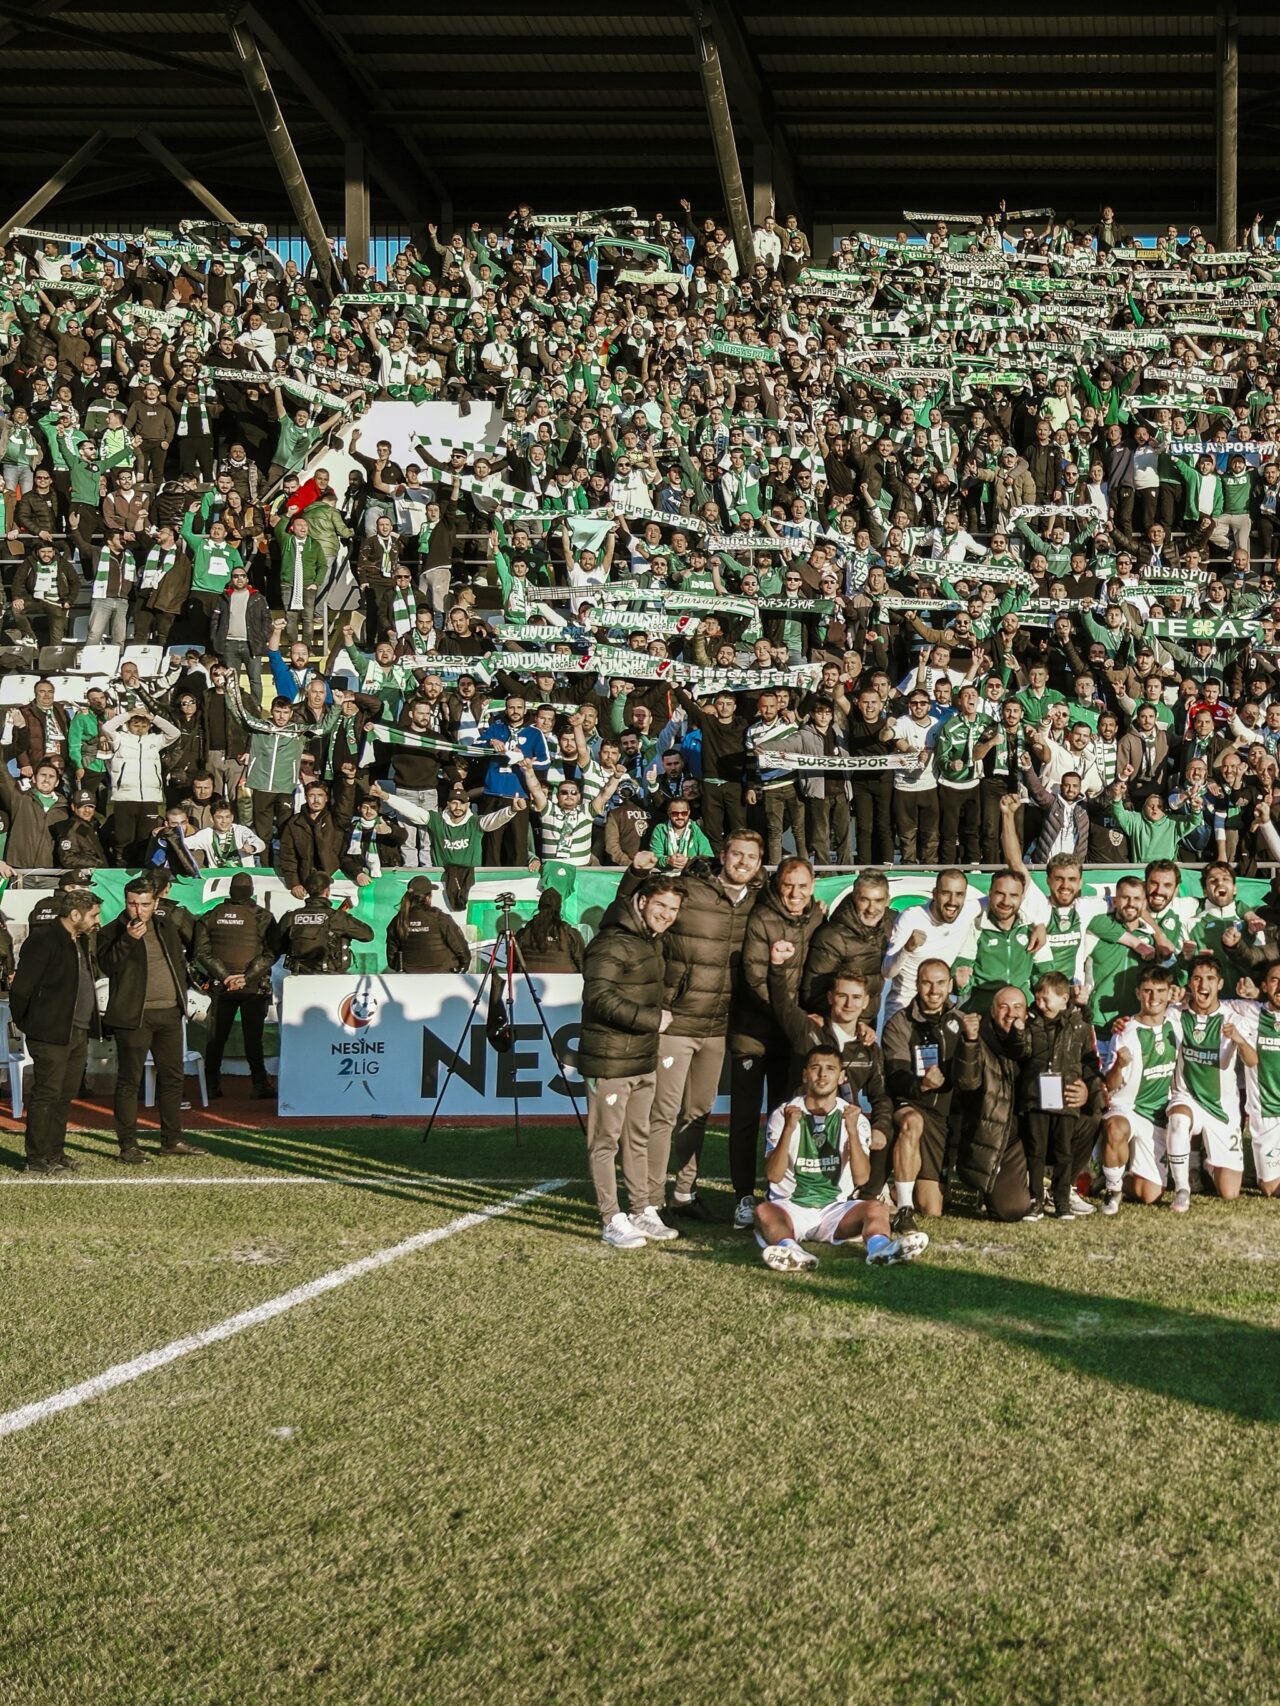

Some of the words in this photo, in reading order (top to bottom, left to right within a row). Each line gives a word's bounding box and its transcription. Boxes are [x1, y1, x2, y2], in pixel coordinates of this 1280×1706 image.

[871, 239, 924, 253] BURSASPOR
[1039, 305, 1103, 319] BURSASPOR
[1169, 442, 1255, 456] URSAPOR
[616, 502, 699, 531] BURSASPOR
[758, 597, 815, 610] BURSASPOR
[797, 756, 889, 769] BURSASPOR
[420, 1022, 588, 1099] NES
